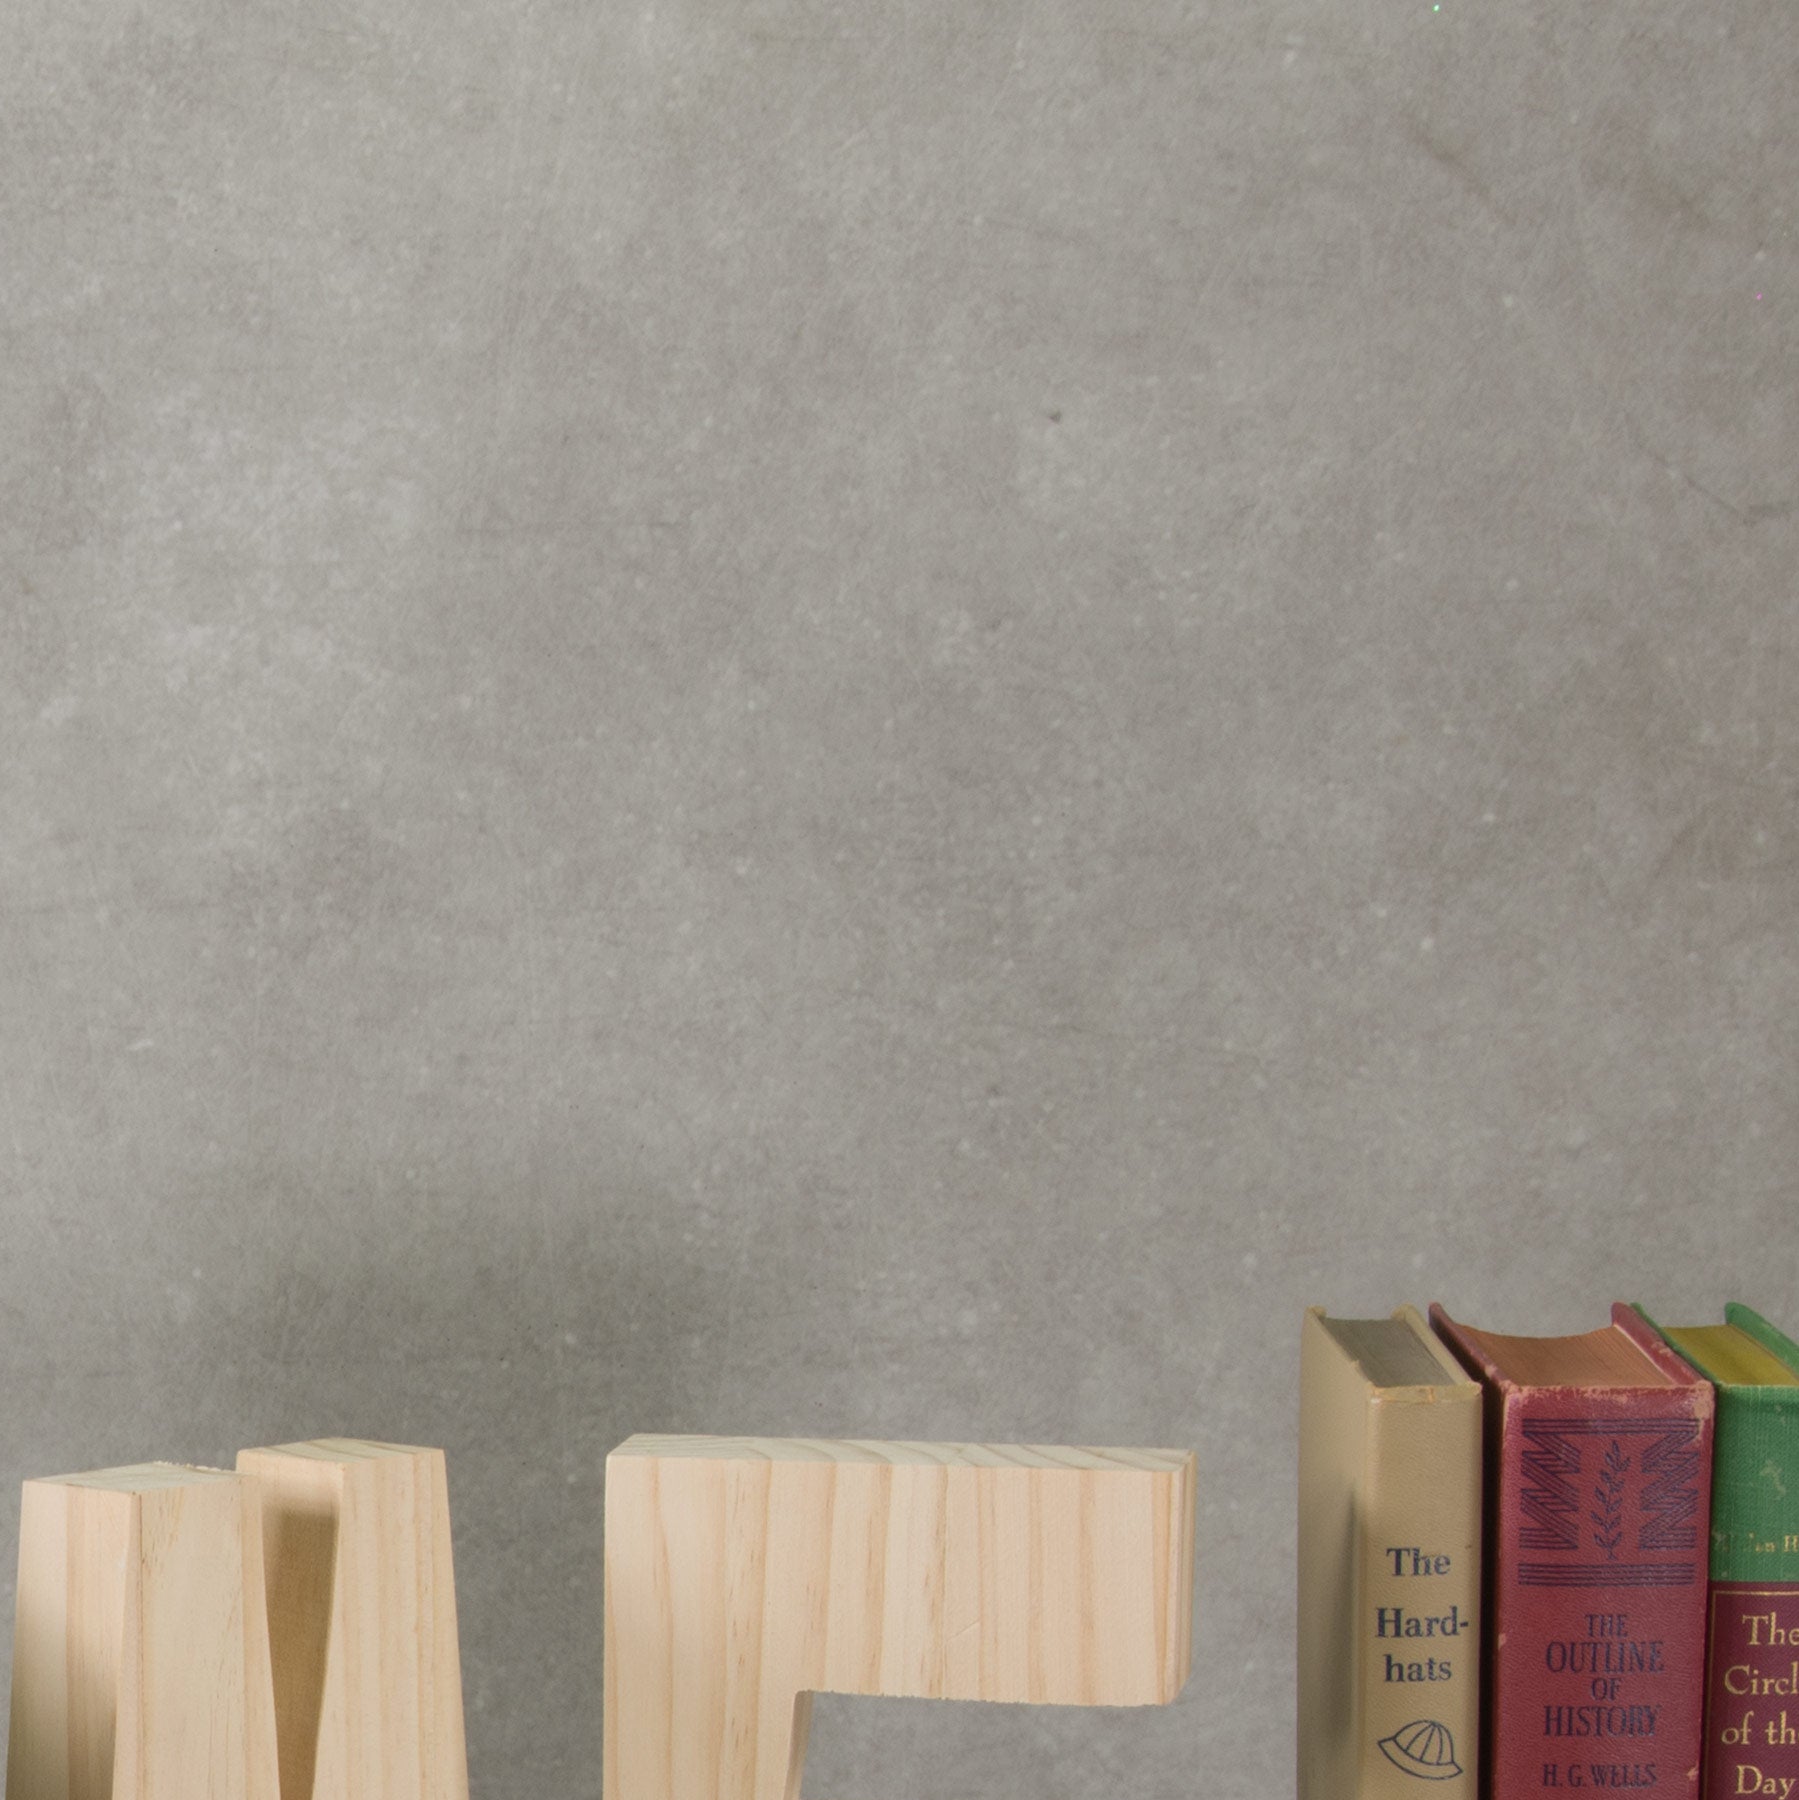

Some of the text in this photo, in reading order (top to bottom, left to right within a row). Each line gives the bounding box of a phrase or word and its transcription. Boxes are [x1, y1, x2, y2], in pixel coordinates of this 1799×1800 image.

[1386, 1547, 1451, 1577] The
[1375, 1605, 1469, 1638] Hard-
[1585, 1614, 1628, 1638] THE
[1742, 1612, 1799, 1646] The
[1383, 1653, 1453, 1683] hats
[1546, 1641, 1665, 1673] OUTLINE
[1591, 1677, 1622, 1701] OF
[1543, 1704, 1661, 1737] HISTORY
[1721, 1710, 1799, 1745] of th
[1590, 1763, 1657, 1789] WELLS
[1735, 1764, 1796, 1800] Day
